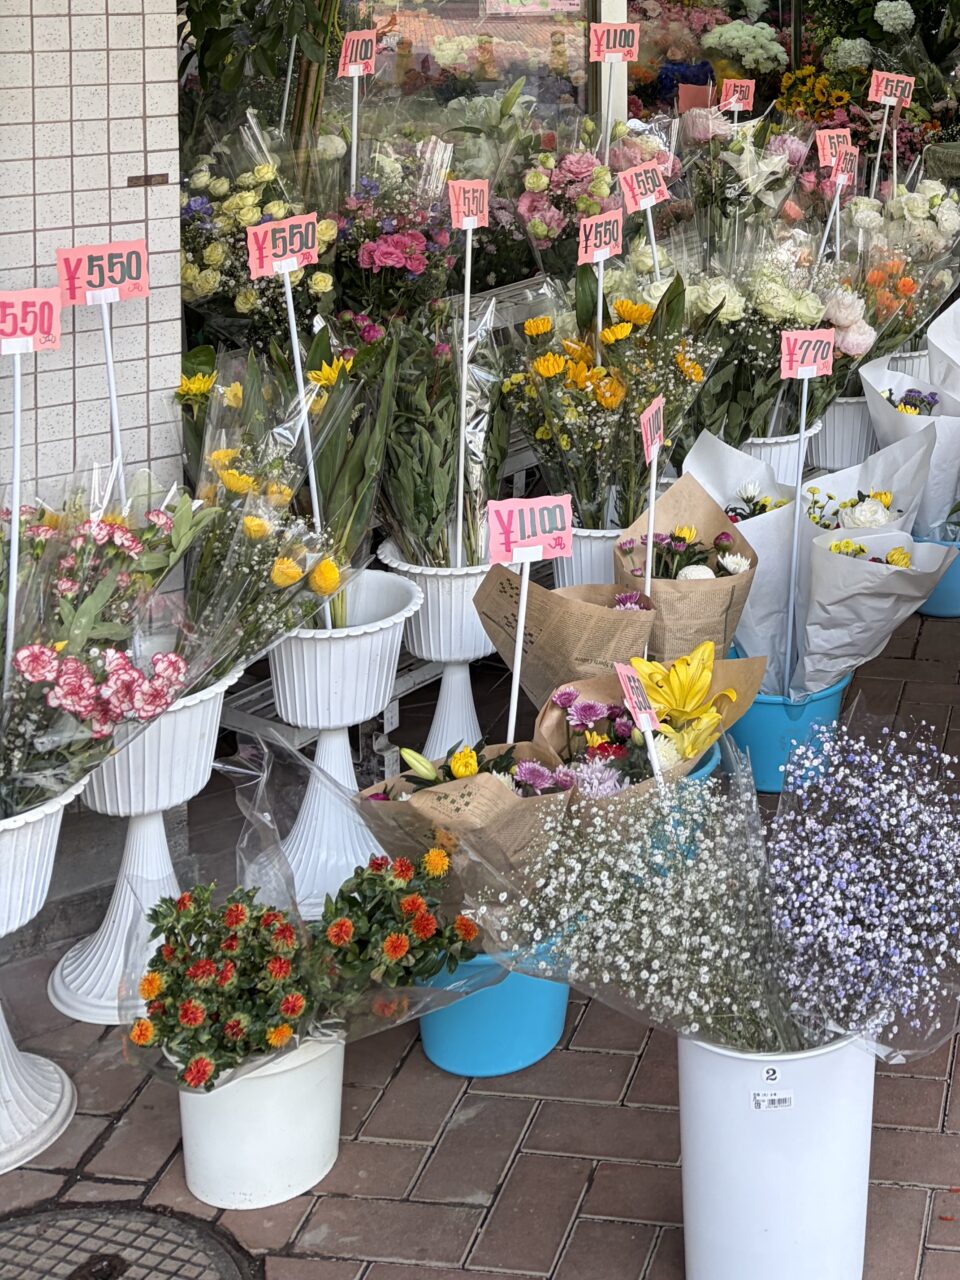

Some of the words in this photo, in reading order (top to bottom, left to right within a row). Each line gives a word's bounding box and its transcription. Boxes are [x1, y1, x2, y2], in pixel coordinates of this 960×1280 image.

[451, 185, 485, 223] ¥550
[623, 168, 662, 206] ¥550
[252, 221, 316, 269] ¥550
[582, 219, 619, 254] ¥550
[63, 251, 142, 300] ¥550
[786, 336, 831, 371] ¥770
[765, 1067, 777, 1081] 2
